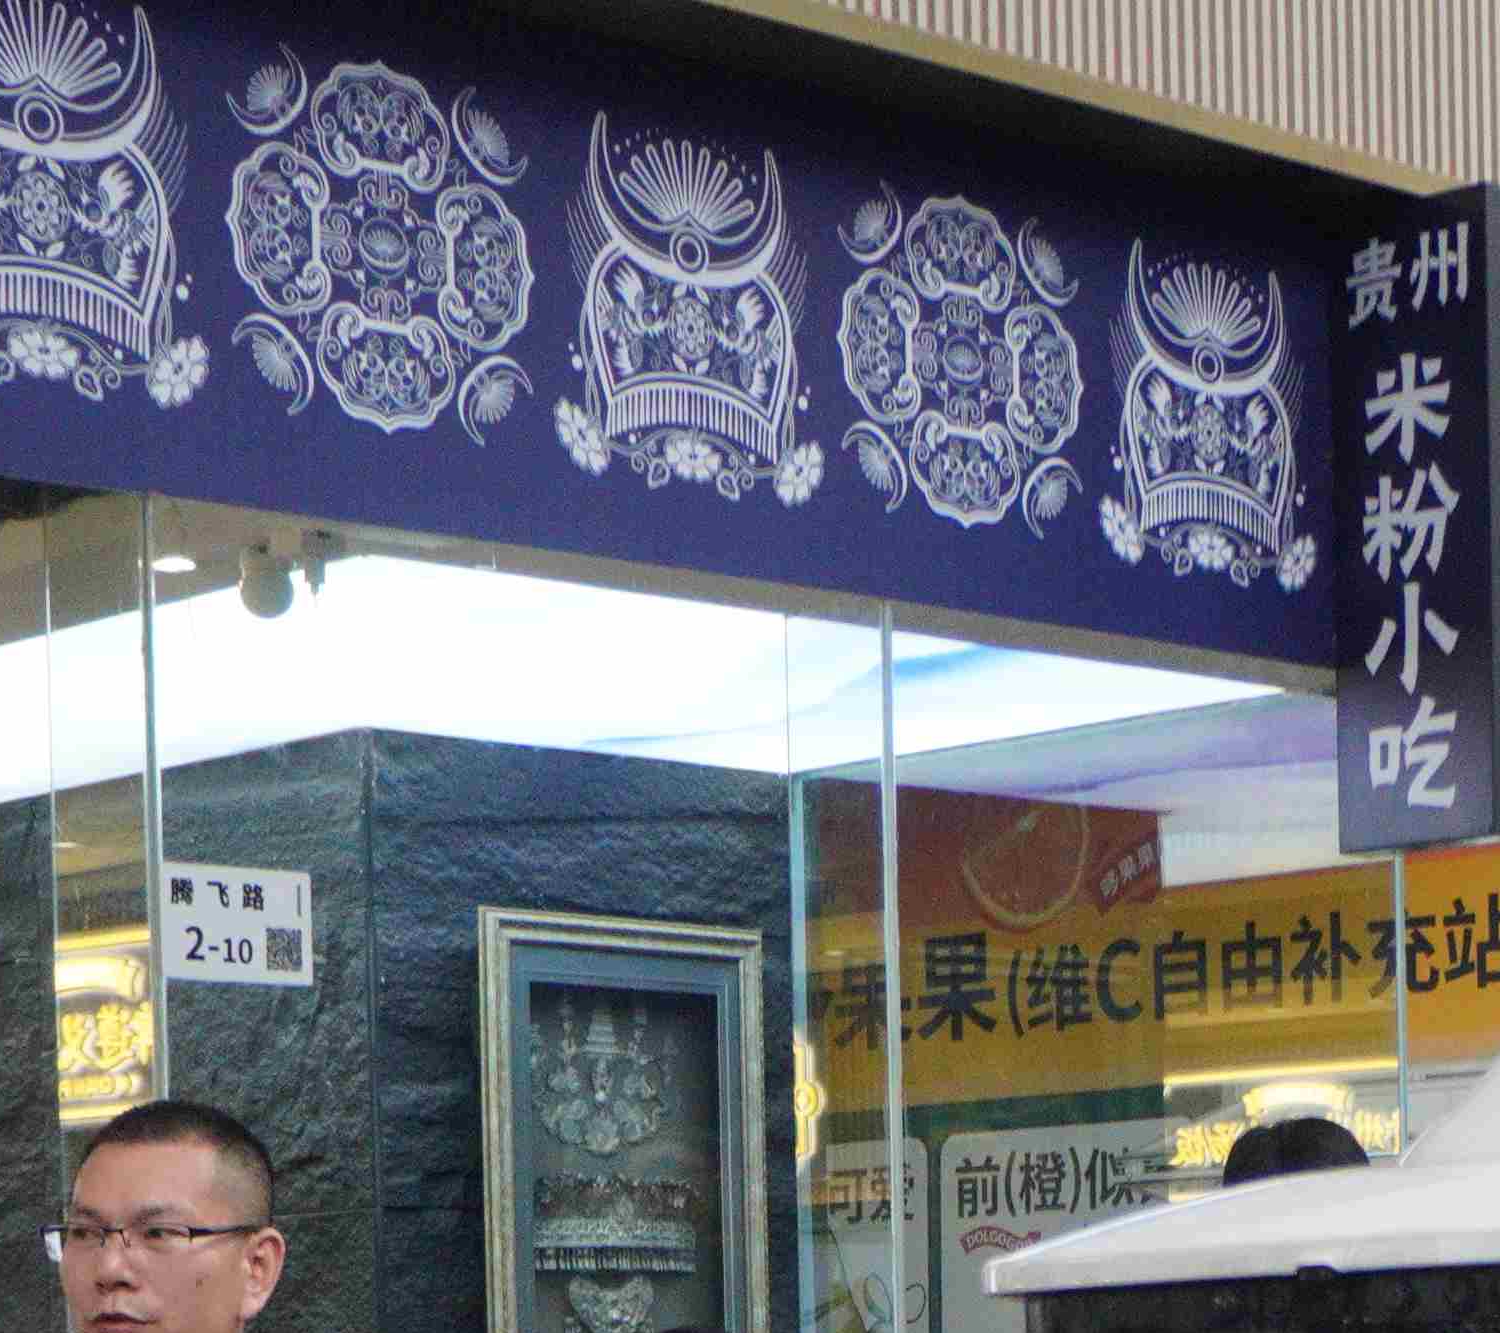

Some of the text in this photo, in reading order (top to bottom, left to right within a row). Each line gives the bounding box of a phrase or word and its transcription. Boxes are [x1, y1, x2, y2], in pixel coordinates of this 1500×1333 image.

[1346, 221, 1472, 331] 贵州
[1361, 350, 1461, 812] 米粉小吃
[171, 876, 264, 912] 腾飞路
[185, 925, 253, 965] 2-10
